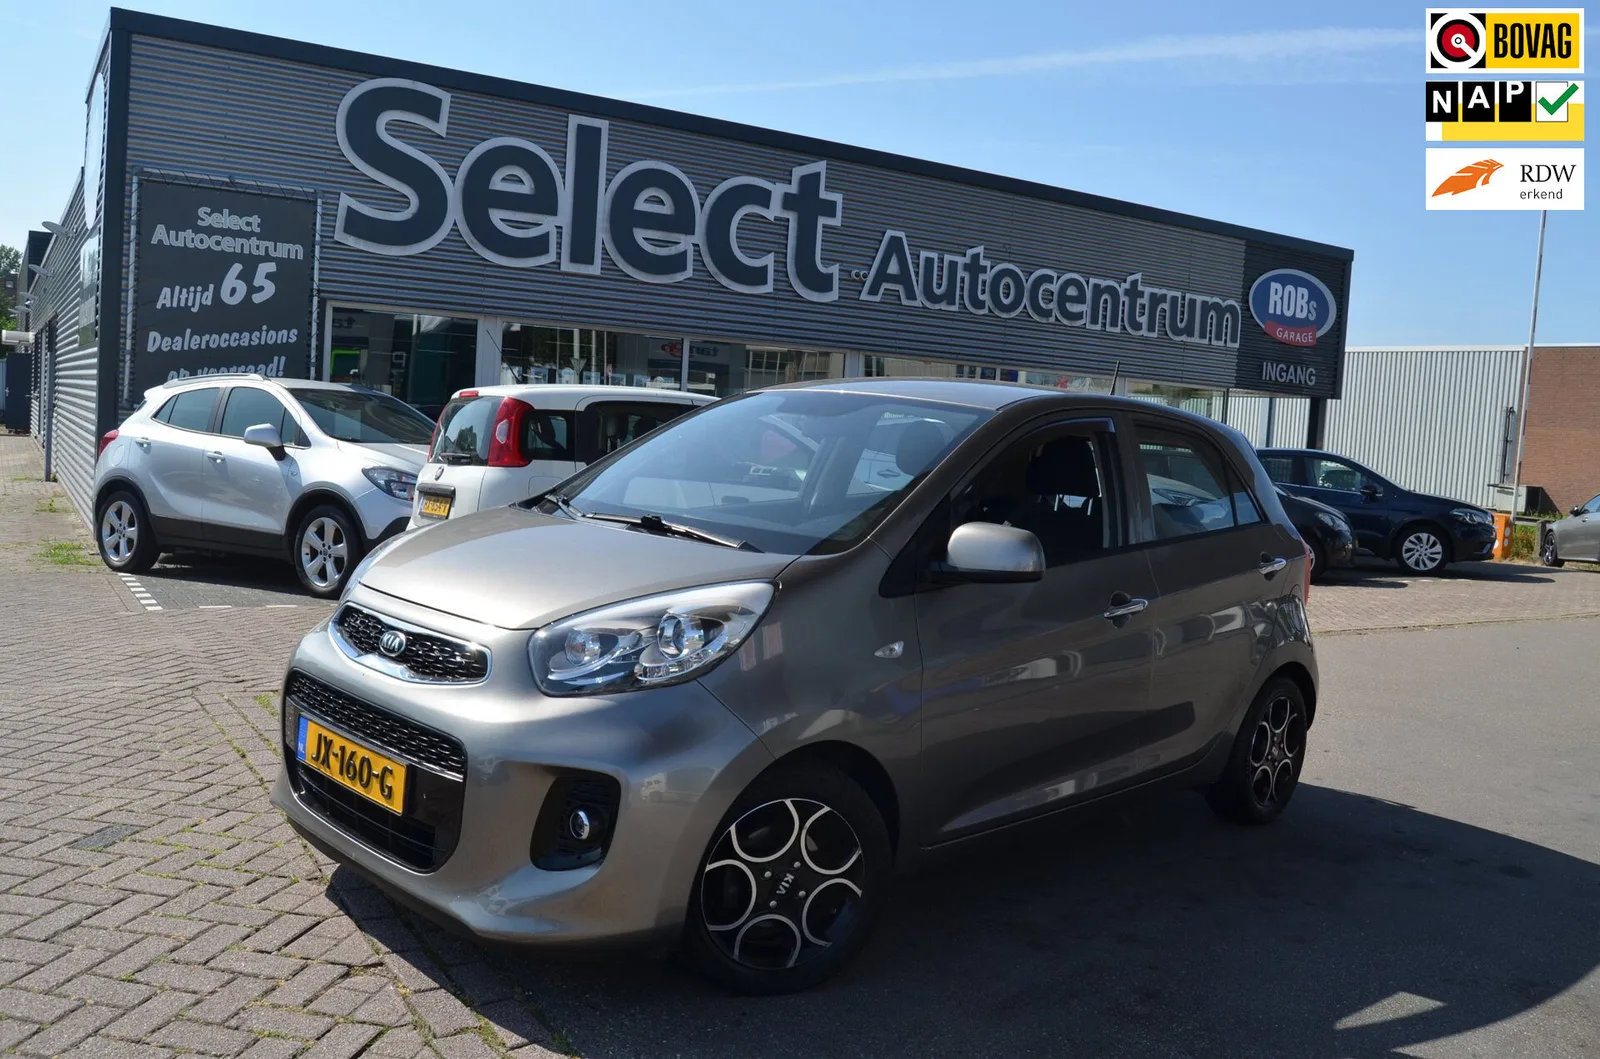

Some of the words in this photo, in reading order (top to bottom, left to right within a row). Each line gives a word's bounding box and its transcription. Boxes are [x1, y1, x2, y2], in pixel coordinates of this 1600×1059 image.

[196, 206, 261, 233] Select
[333, 77, 844, 303] Select
[859, 229, 1242, 348] Autocentrum
[150, 223, 304, 260] Autocentrum
[155, 283, 215, 313] Altijd
[219, 261, 277, 306] 65
[1268, 281, 1317, 321] ROBs
[146, 324, 299, 353] Dealeroccasions
[1276, 327, 1313, 343] GARAGE
[1262, 361, 1316, 386] INGANG
[381, 632, 401, 651] KIA
[311, 732, 393, 801] JX-160-G
[775, 872, 795, 896] KIA
